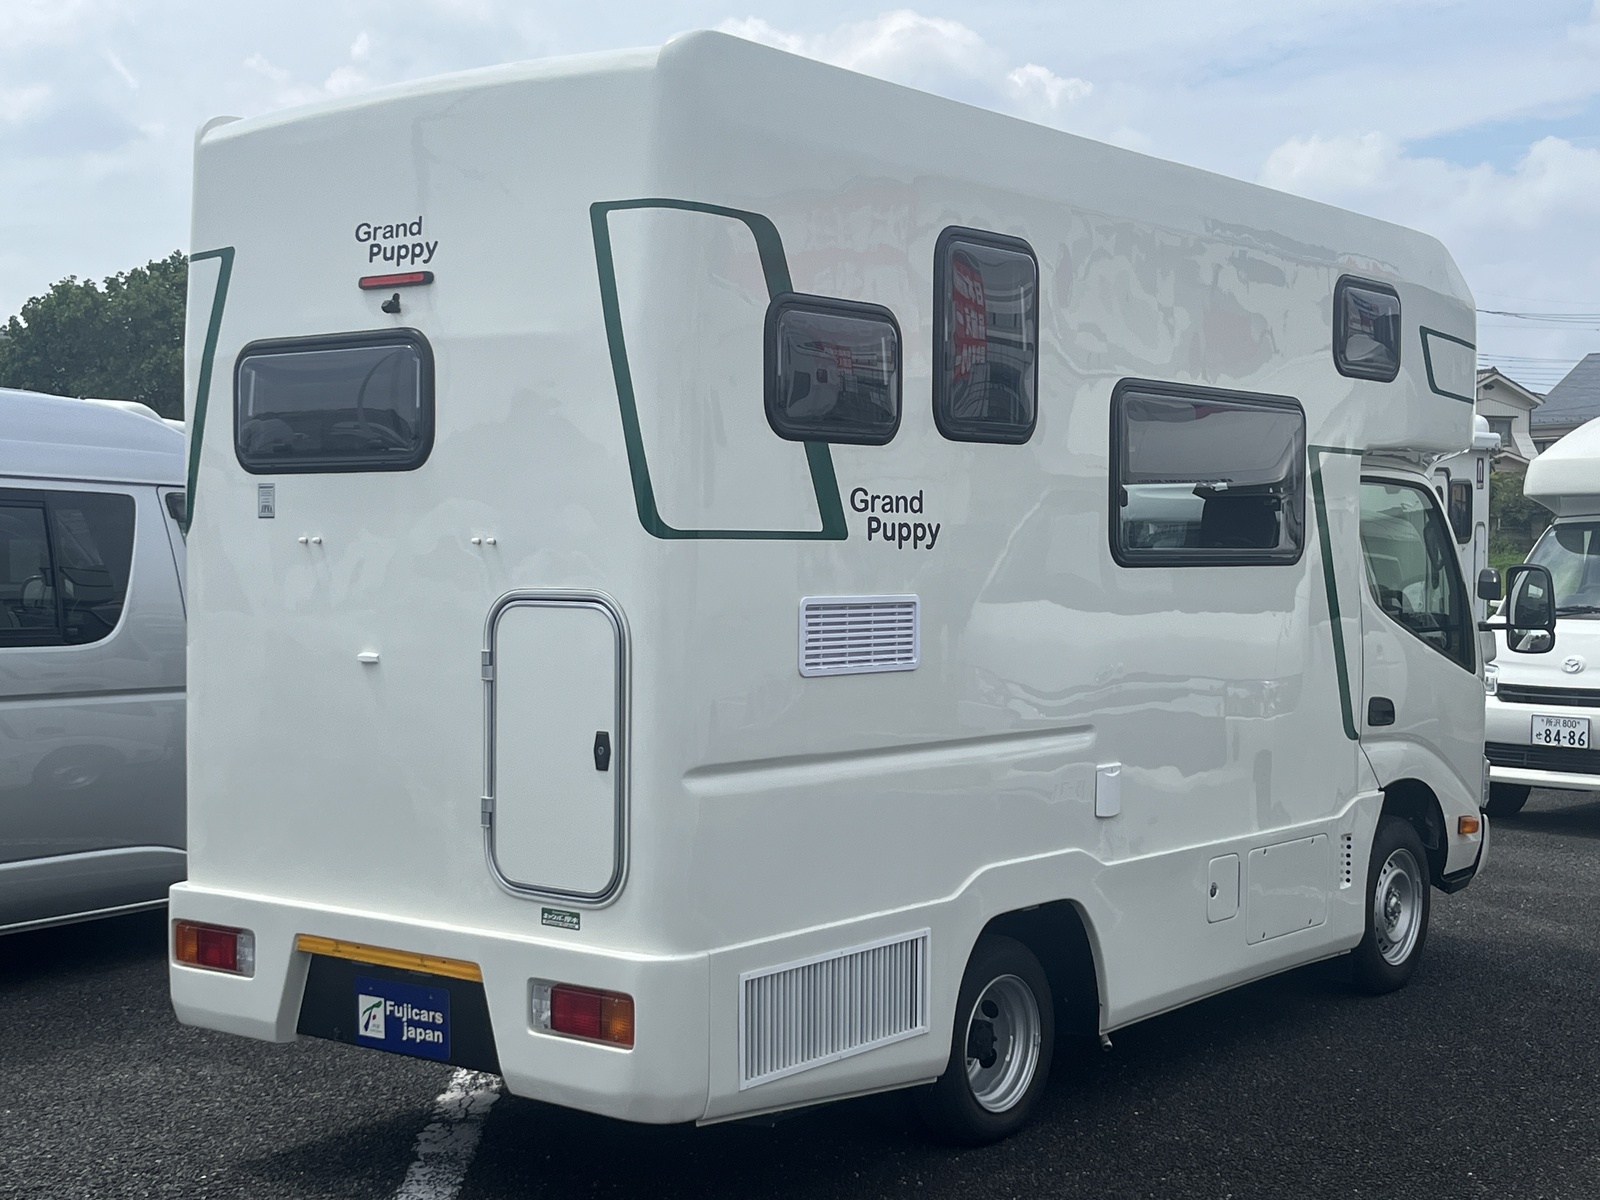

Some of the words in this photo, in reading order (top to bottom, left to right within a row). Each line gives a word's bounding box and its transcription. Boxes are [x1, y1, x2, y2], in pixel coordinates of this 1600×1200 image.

[355, 215, 423, 243] Grand
[368, 240, 439, 267] Puppy
[850, 487, 923, 514] Grand
[867, 516, 941, 550] Puppy
[1545, 718, 1561, 727] 所沢
[1562, 719, 1577, 729] 800
[1535, 731, 1543, 740] せ
[1544, 728, 1586, 747] 84-86
[385, 1000, 444, 1024] Fujicars
[401, 1022, 443, 1043] japan
